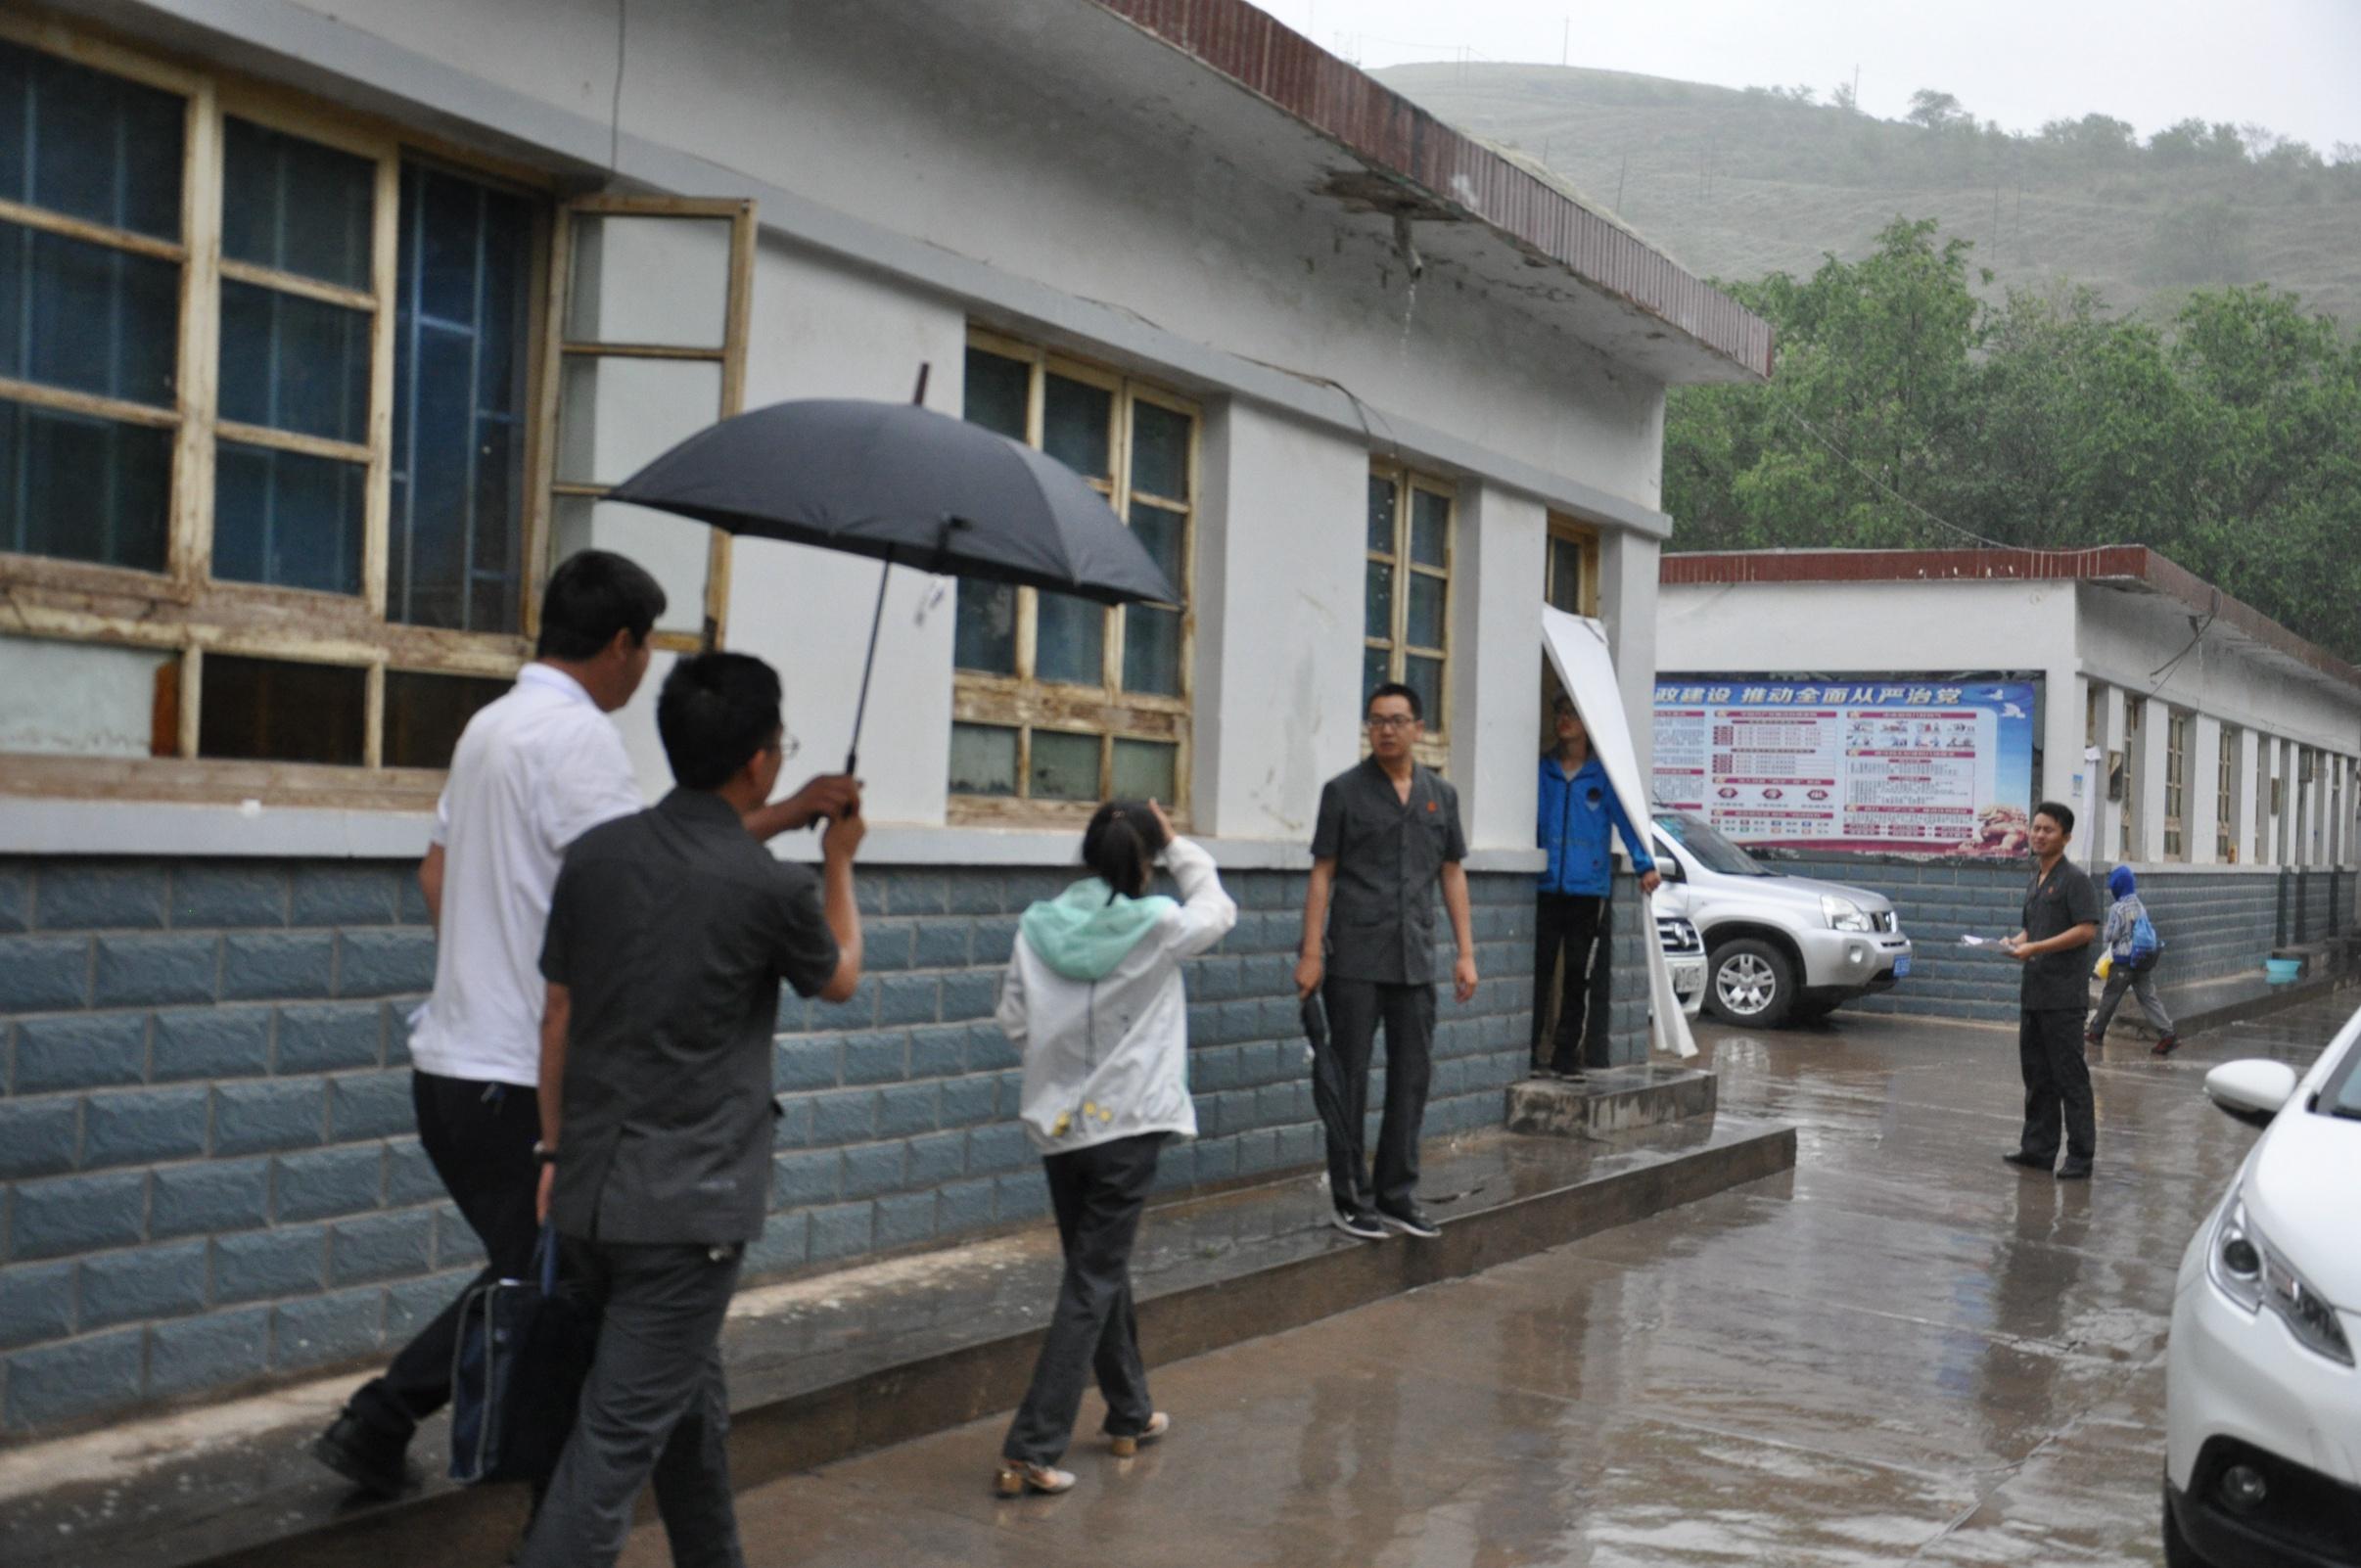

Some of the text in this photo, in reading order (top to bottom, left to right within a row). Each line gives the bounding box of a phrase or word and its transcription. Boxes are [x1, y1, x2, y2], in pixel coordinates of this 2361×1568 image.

[1654, 686, 1963, 705] 政建设 推动全面从严治党
